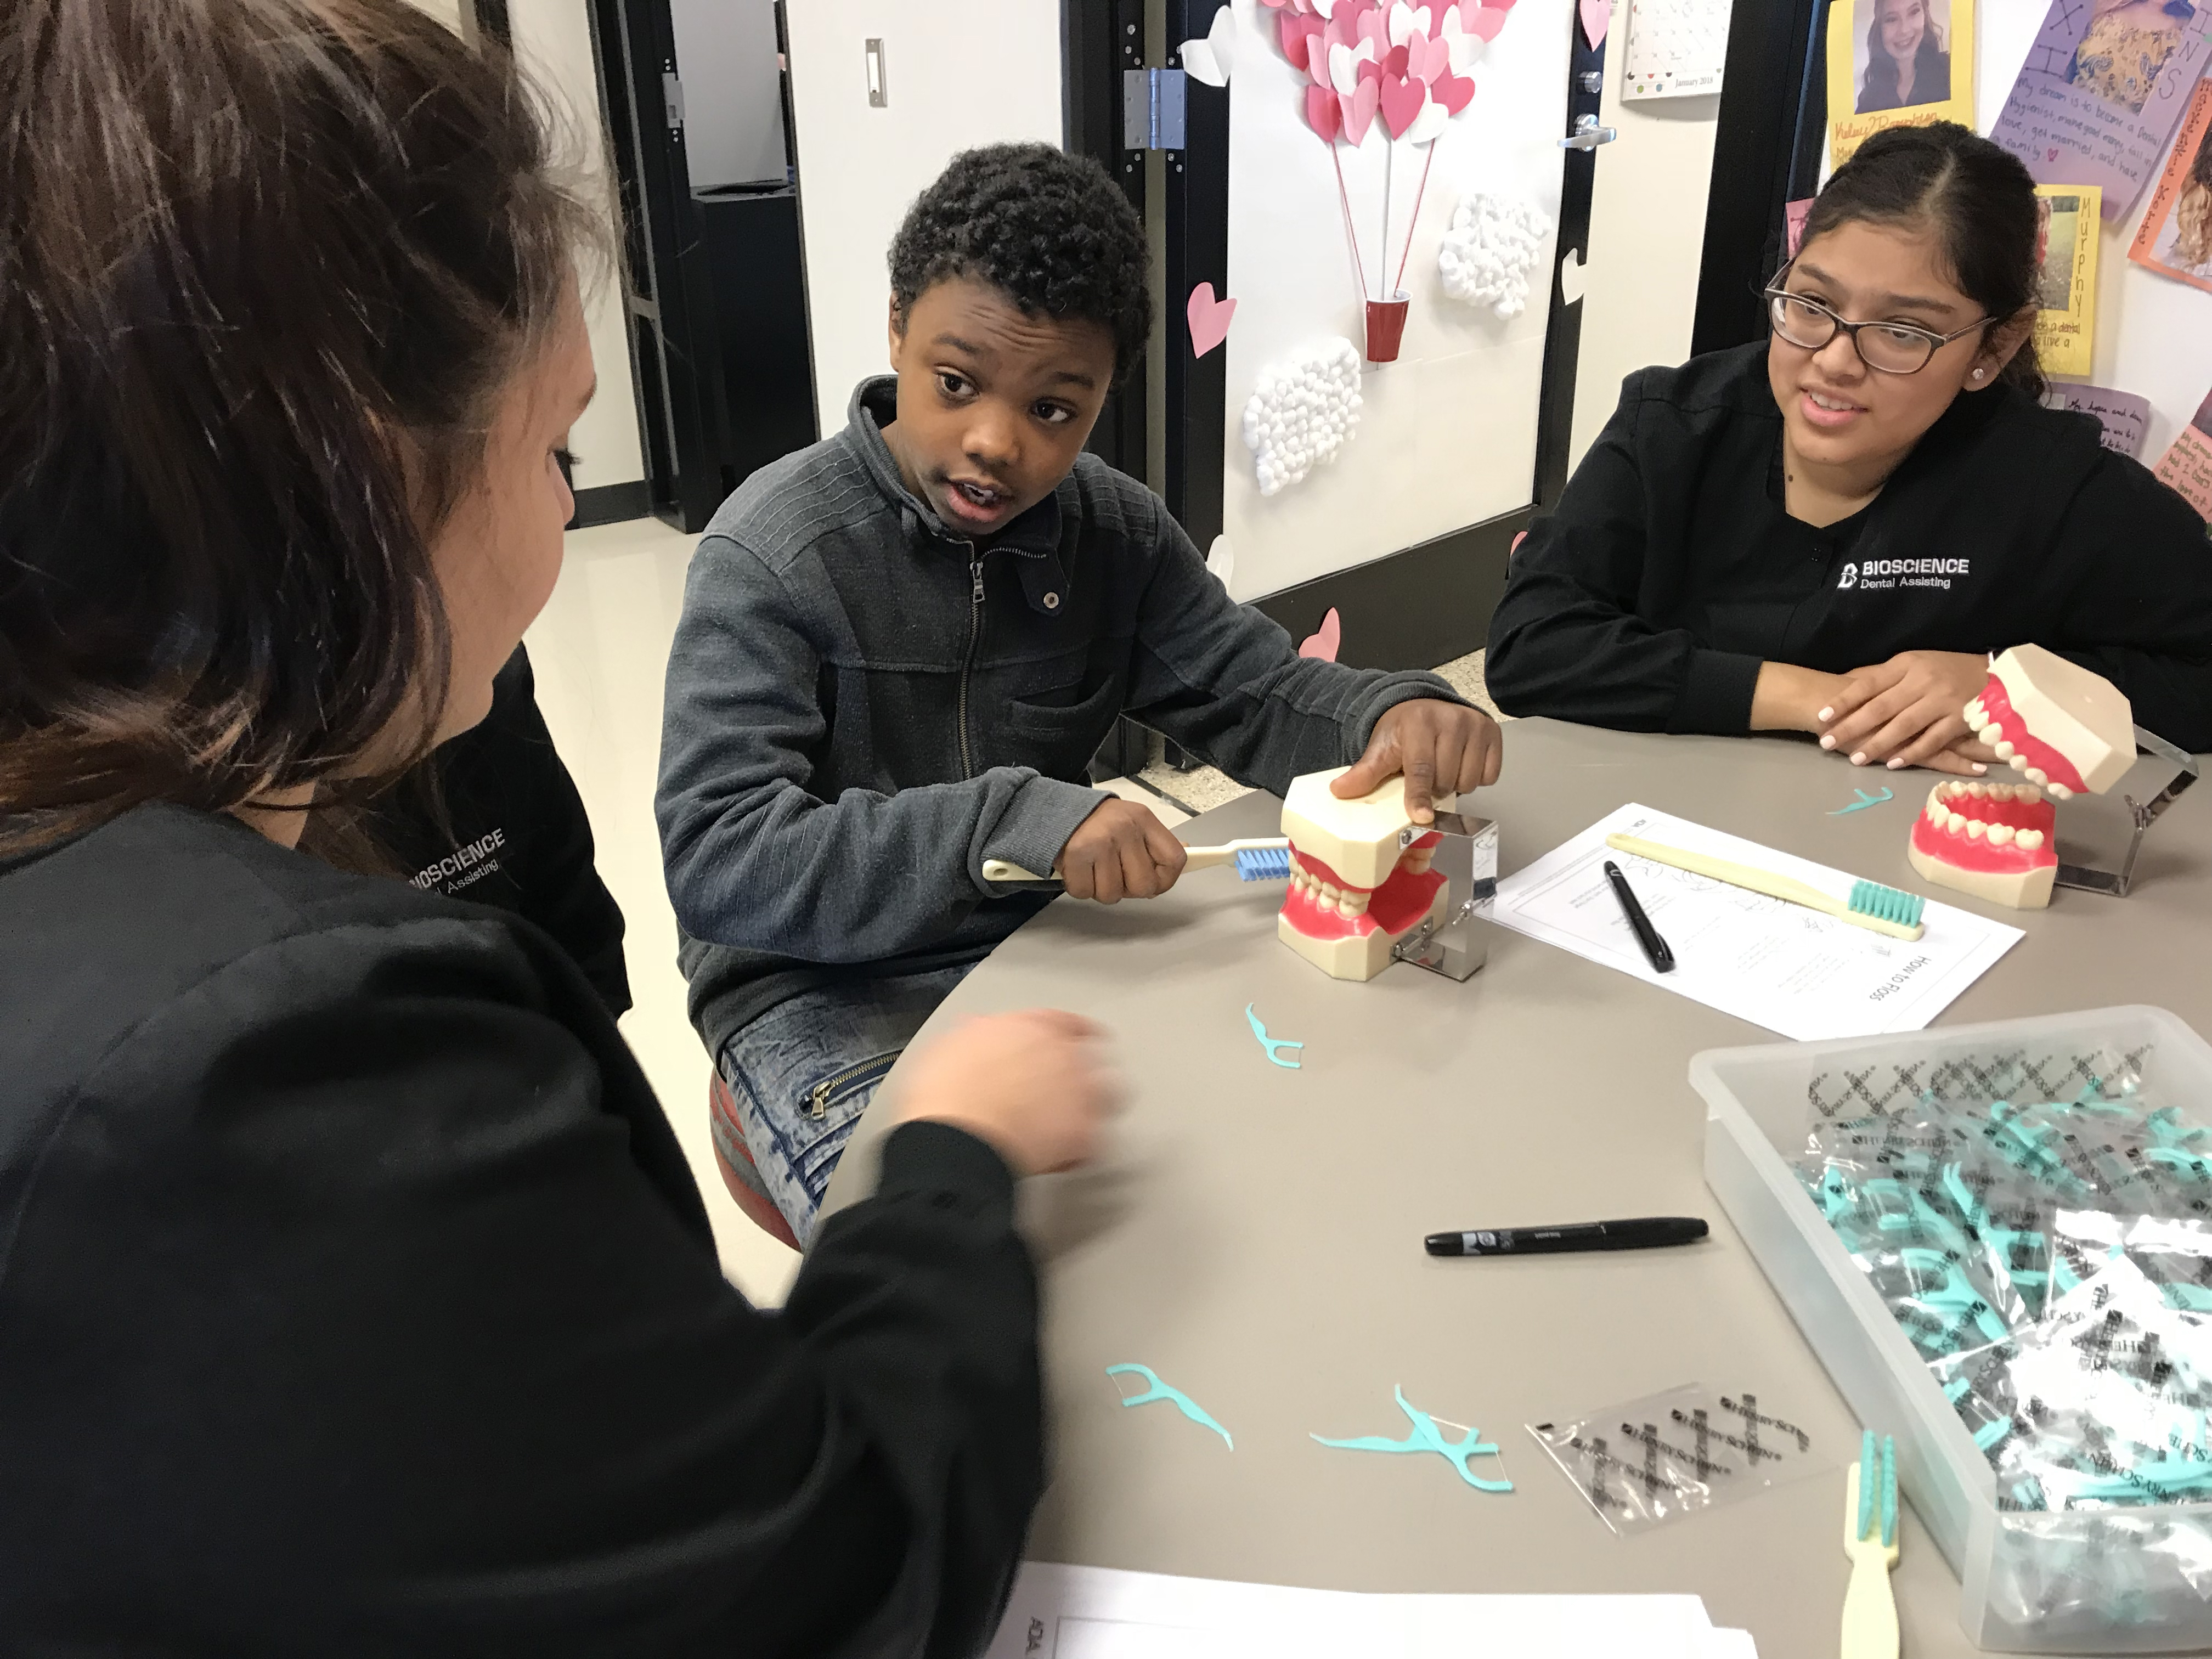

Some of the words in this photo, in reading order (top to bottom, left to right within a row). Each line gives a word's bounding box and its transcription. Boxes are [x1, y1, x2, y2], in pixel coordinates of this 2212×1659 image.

[1675, 78, 1699, 89] January
[1699, 77, 1714, 86] 2018
[2018, 77, 2033, 98] My
[2039, 84, 2067, 102] dream
[2071, 97, 2079, 108] is
[2081, 100, 2092, 112] to
[2128, 124, 2135, 133] a
[2032, 126, 2048, 140] get
[2098, 153, 2117, 167] and
[2119, 161, 2138, 183] have
[2075, 196, 2091, 318] Murphy
[1860, 577, 1895, 589] Dental
[1899, 576, 1951, 590] Assisting
[1862, 558, 1970, 575] BIOSCIENCE
[447, 858, 499, 894] Assisting
